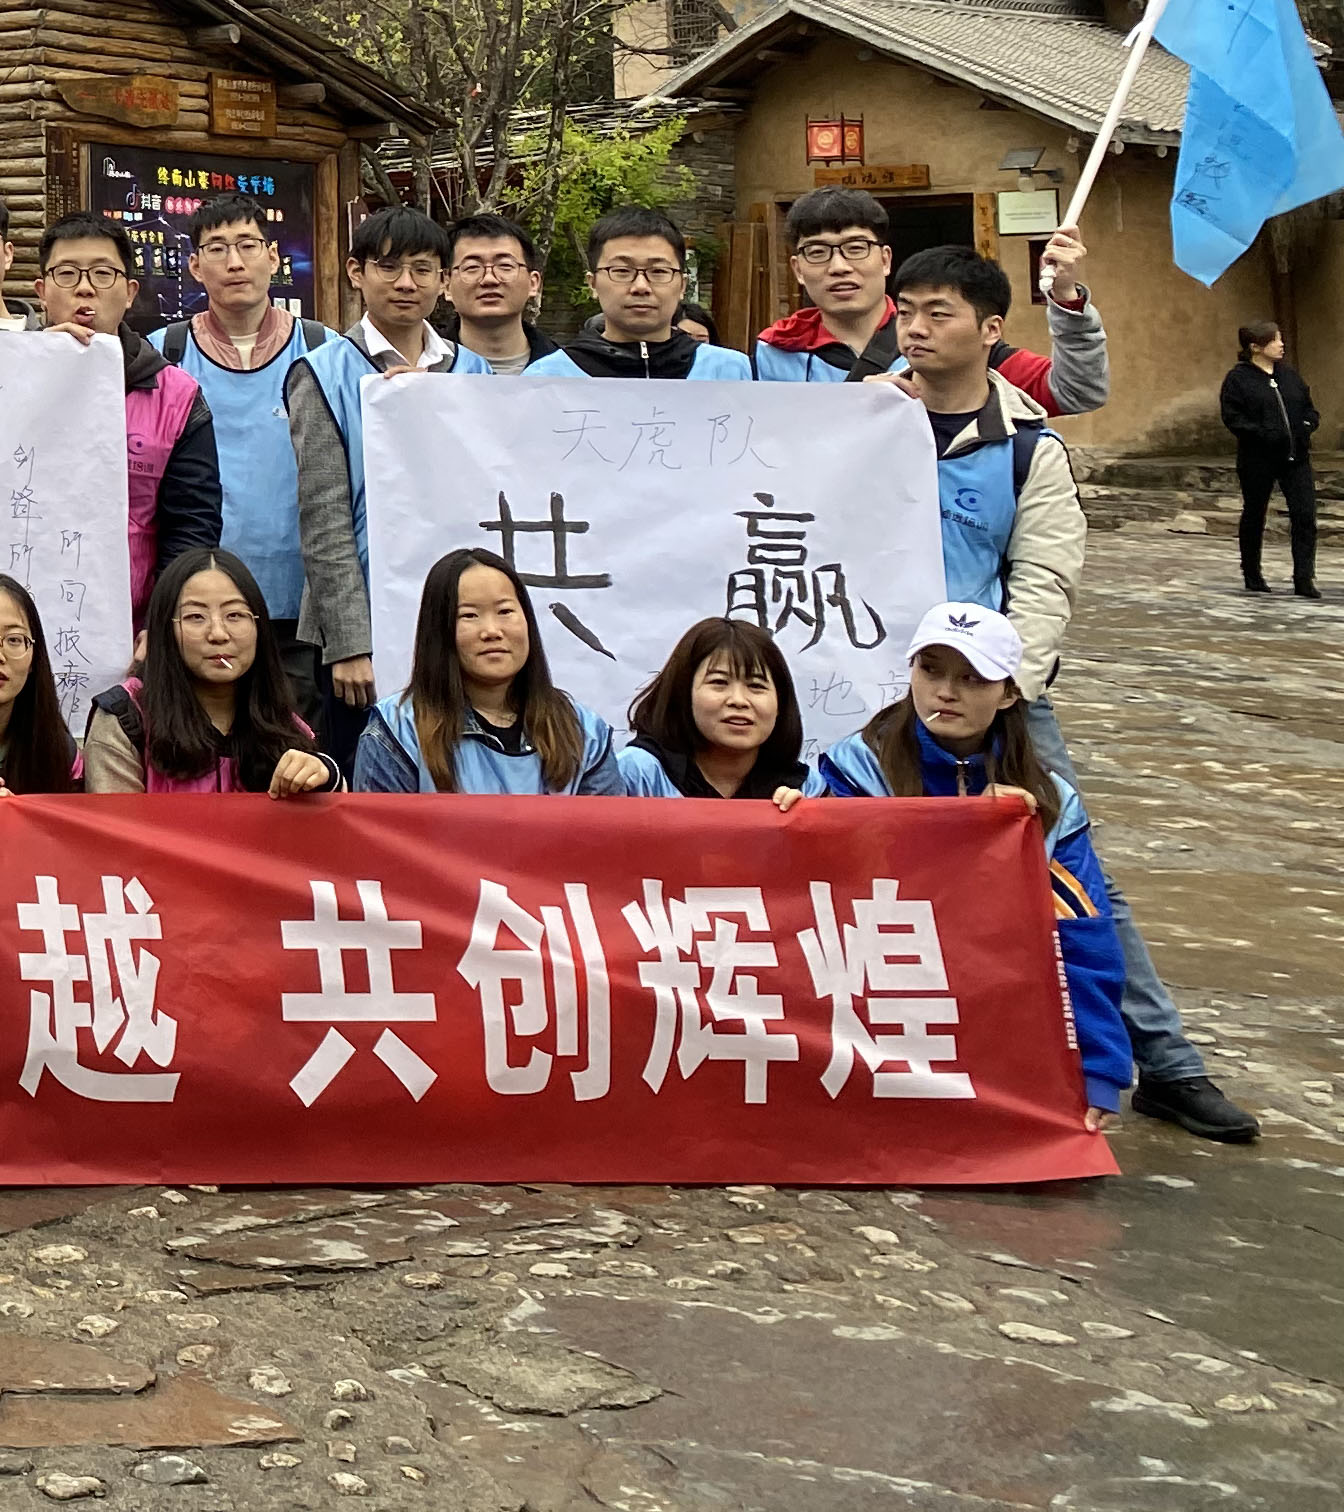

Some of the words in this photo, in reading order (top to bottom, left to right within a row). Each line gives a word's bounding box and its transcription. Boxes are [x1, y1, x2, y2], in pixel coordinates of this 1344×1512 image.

[140, 192, 162, 211] 抖音
[8, 441, 44, 608] 剑锋所
[478, 489, 888, 661] 共赢
[281, 879, 976, 1109] 共创辉煌
